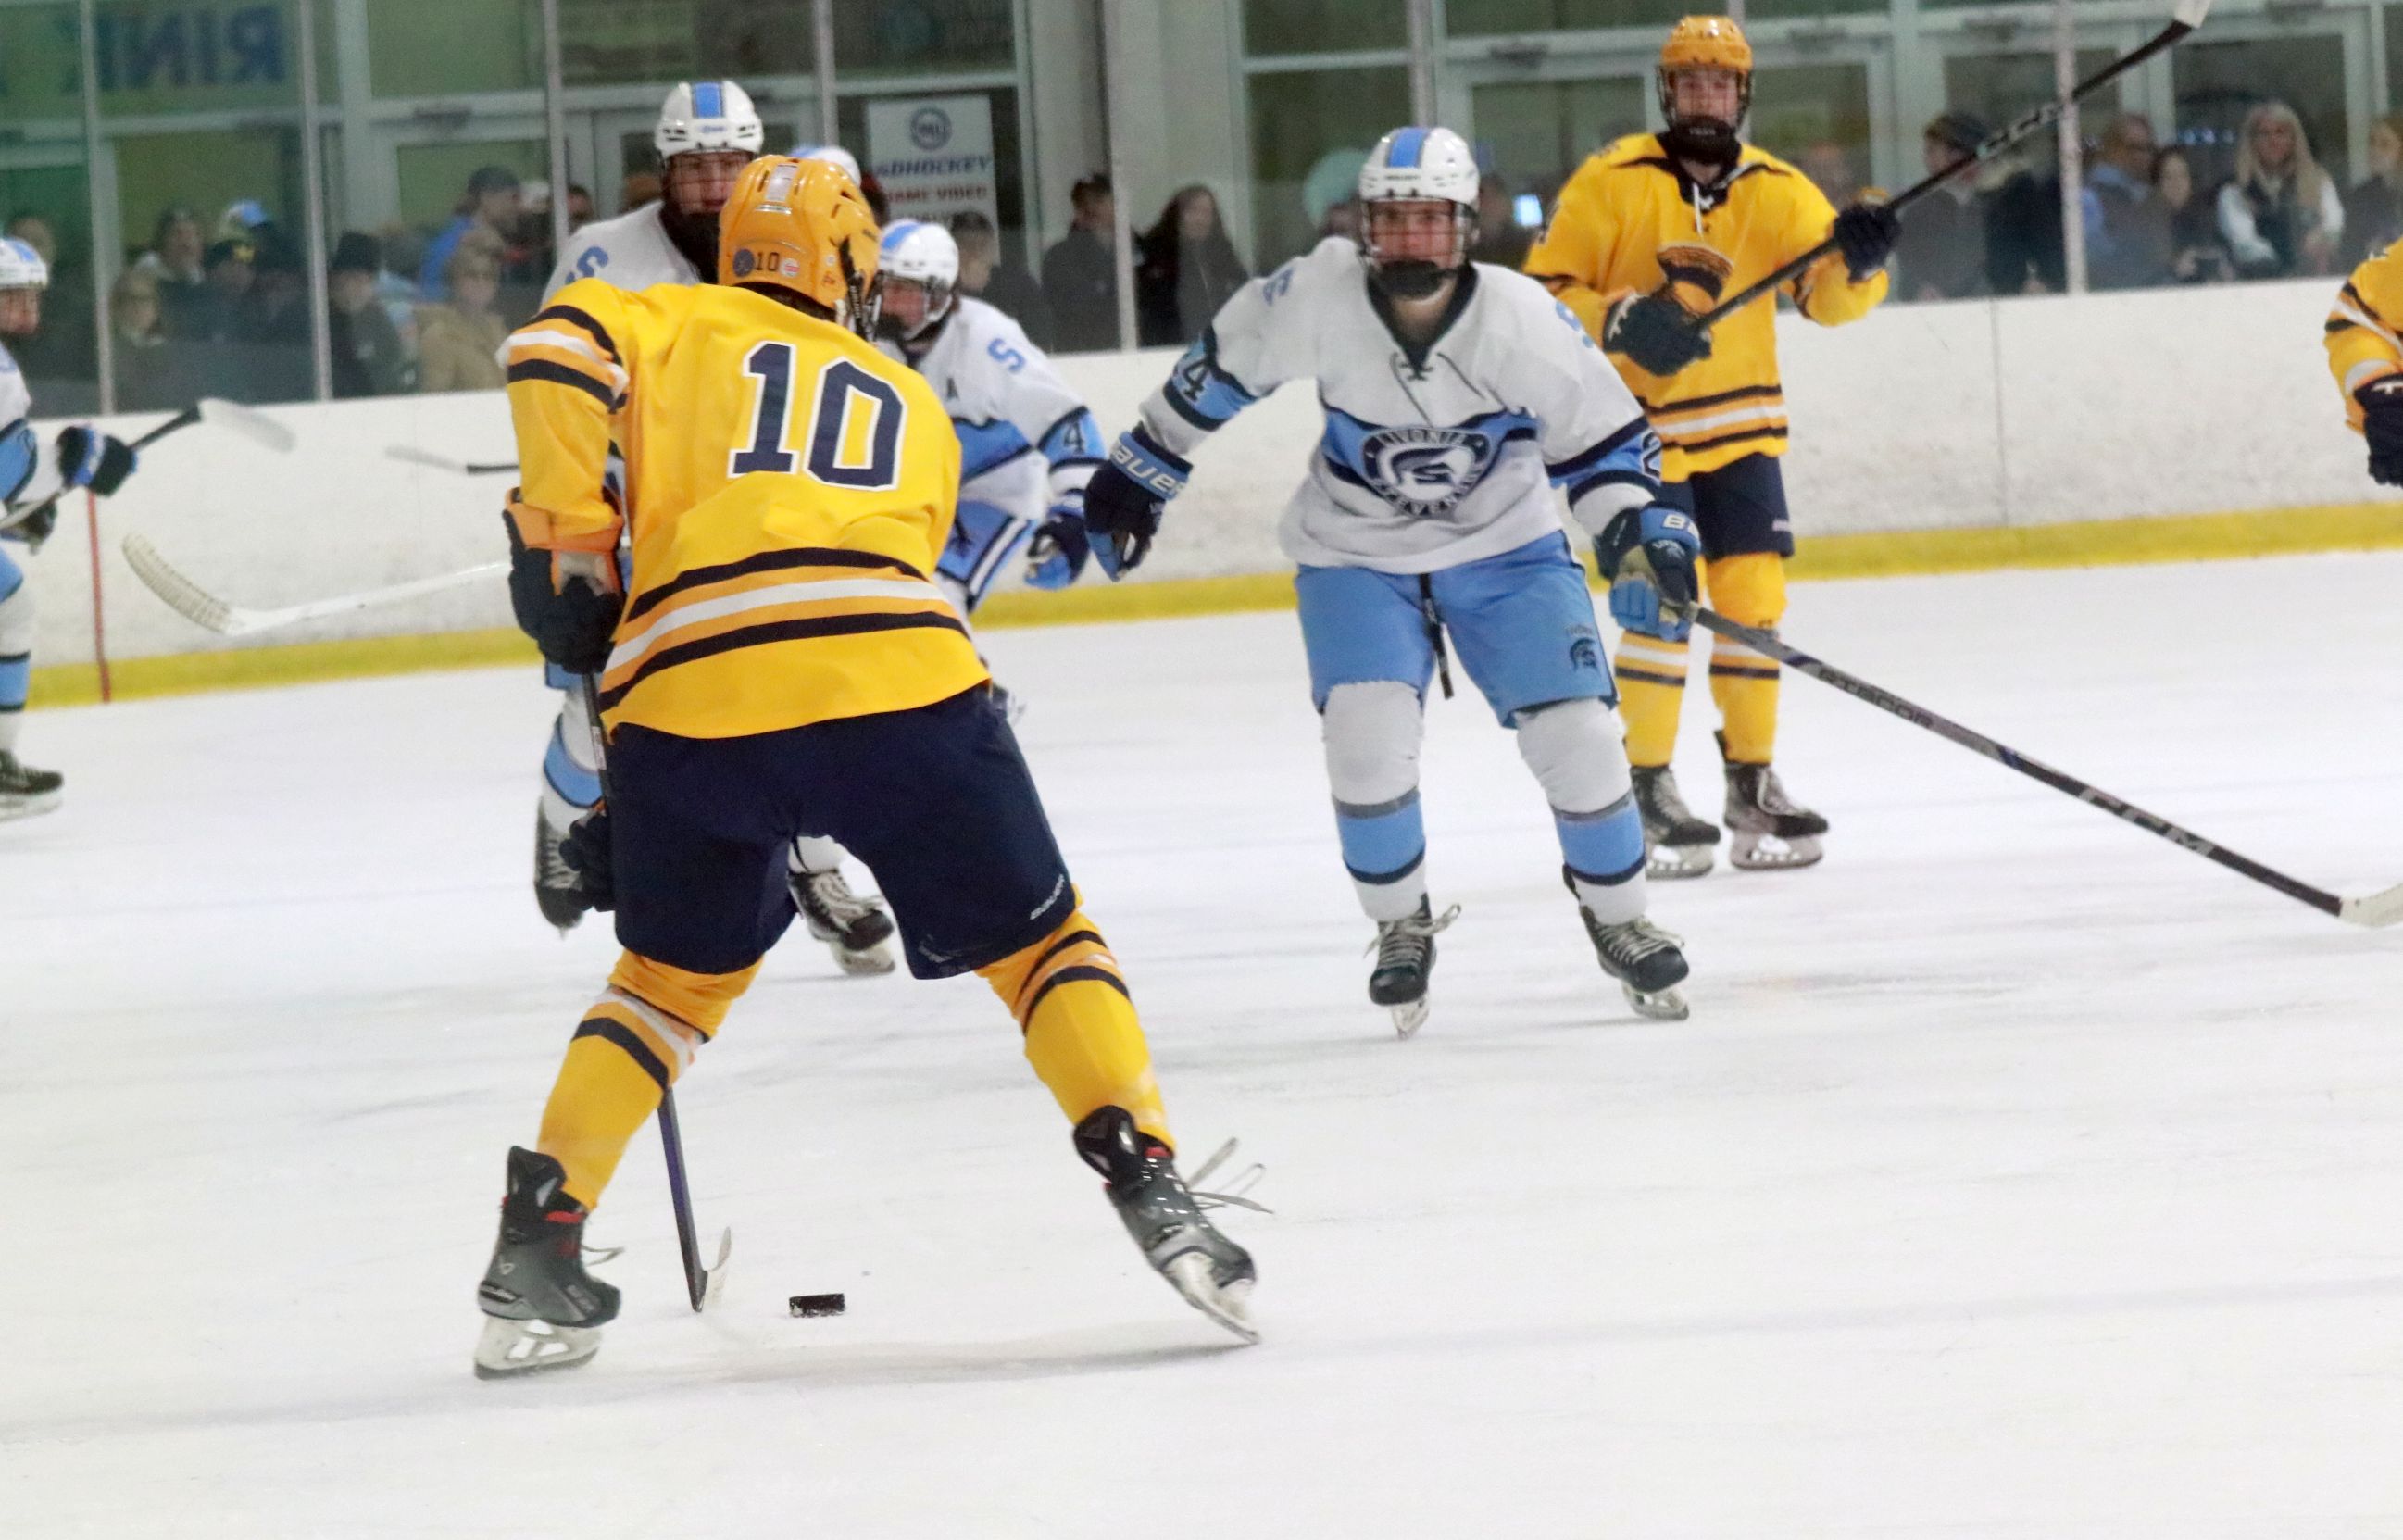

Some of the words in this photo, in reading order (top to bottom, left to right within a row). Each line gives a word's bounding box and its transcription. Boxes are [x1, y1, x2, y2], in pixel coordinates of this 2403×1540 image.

[755, 251, 781, 273] 10
[986, 337, 1026, 371] S
[727, 340, 908, 492] 10
